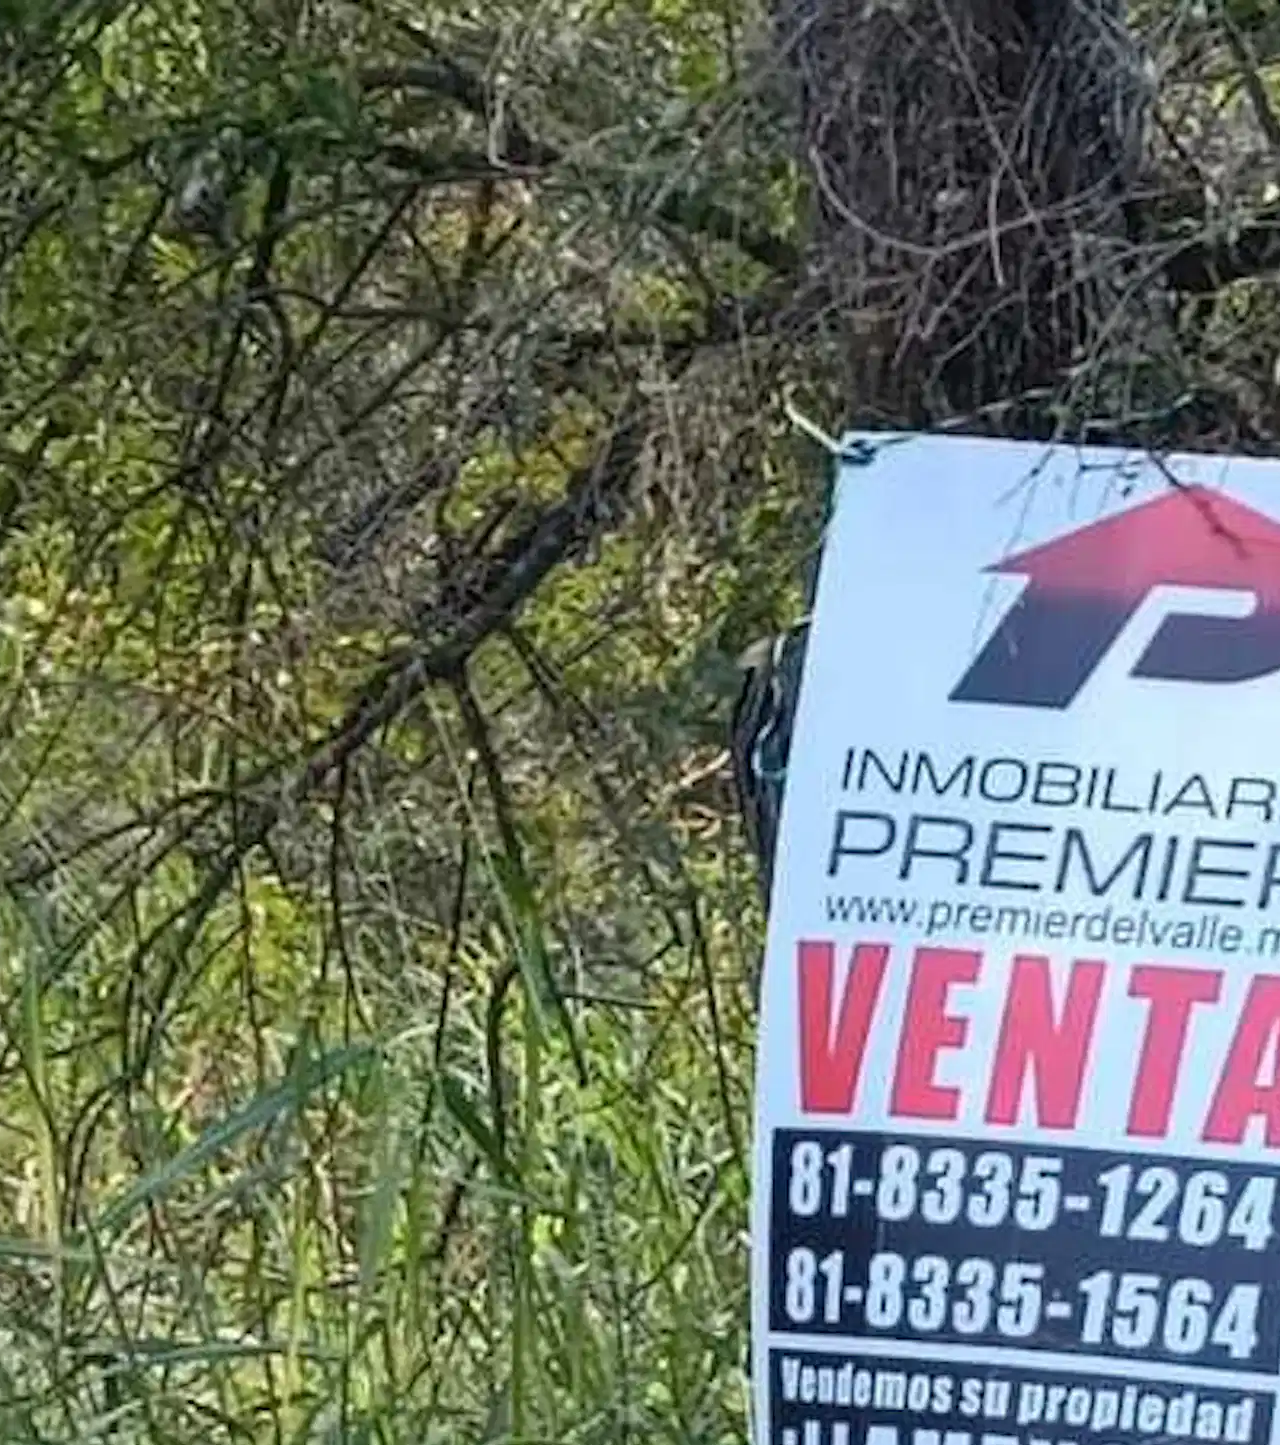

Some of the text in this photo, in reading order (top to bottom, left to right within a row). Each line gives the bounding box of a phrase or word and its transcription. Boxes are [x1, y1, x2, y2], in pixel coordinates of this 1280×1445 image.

[787, 1140, 1278, 1253] 81-8335-1264
[783, 1247, 1261, 1359] 81-8335-1564
[780, 1356, 1254, 1444] Vendemos su propiedad
